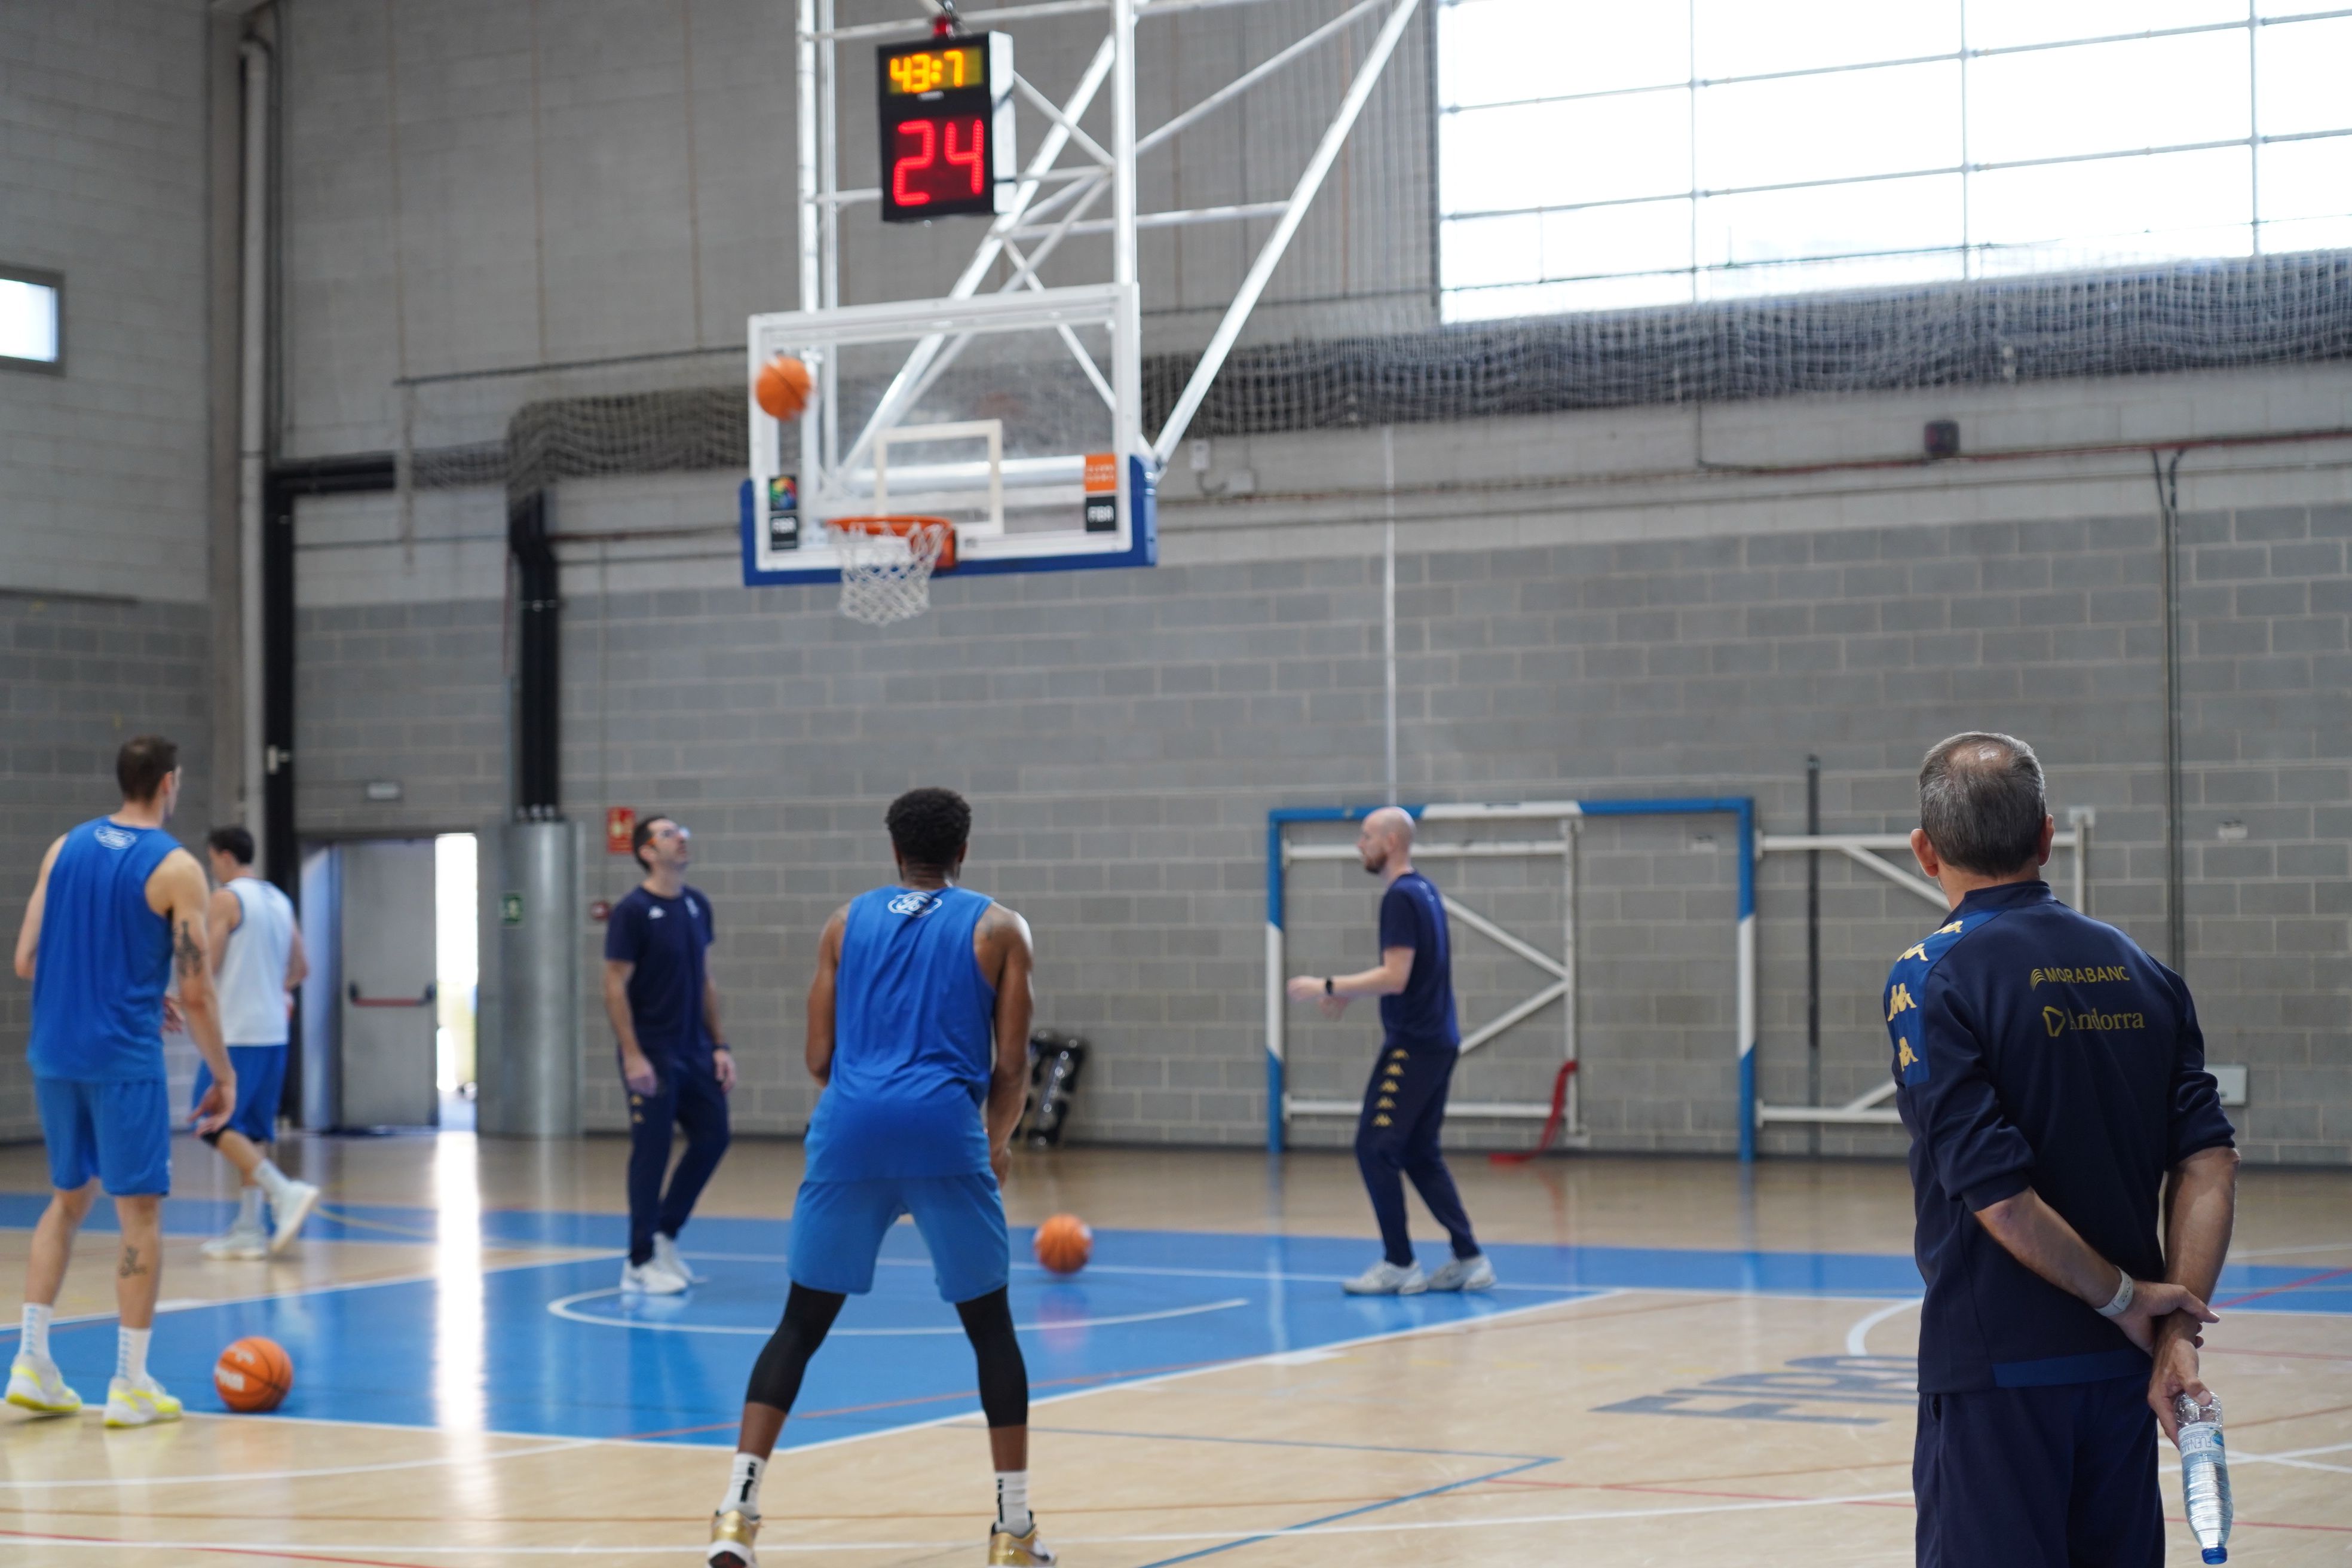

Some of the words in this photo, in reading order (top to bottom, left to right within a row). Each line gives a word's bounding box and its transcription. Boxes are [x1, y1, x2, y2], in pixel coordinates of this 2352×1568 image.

[893, 119, 984, 206] 24
[2044, 966, 2129, 983] MORABANC
[2067, 1007, 2145, 1030] Andorra
